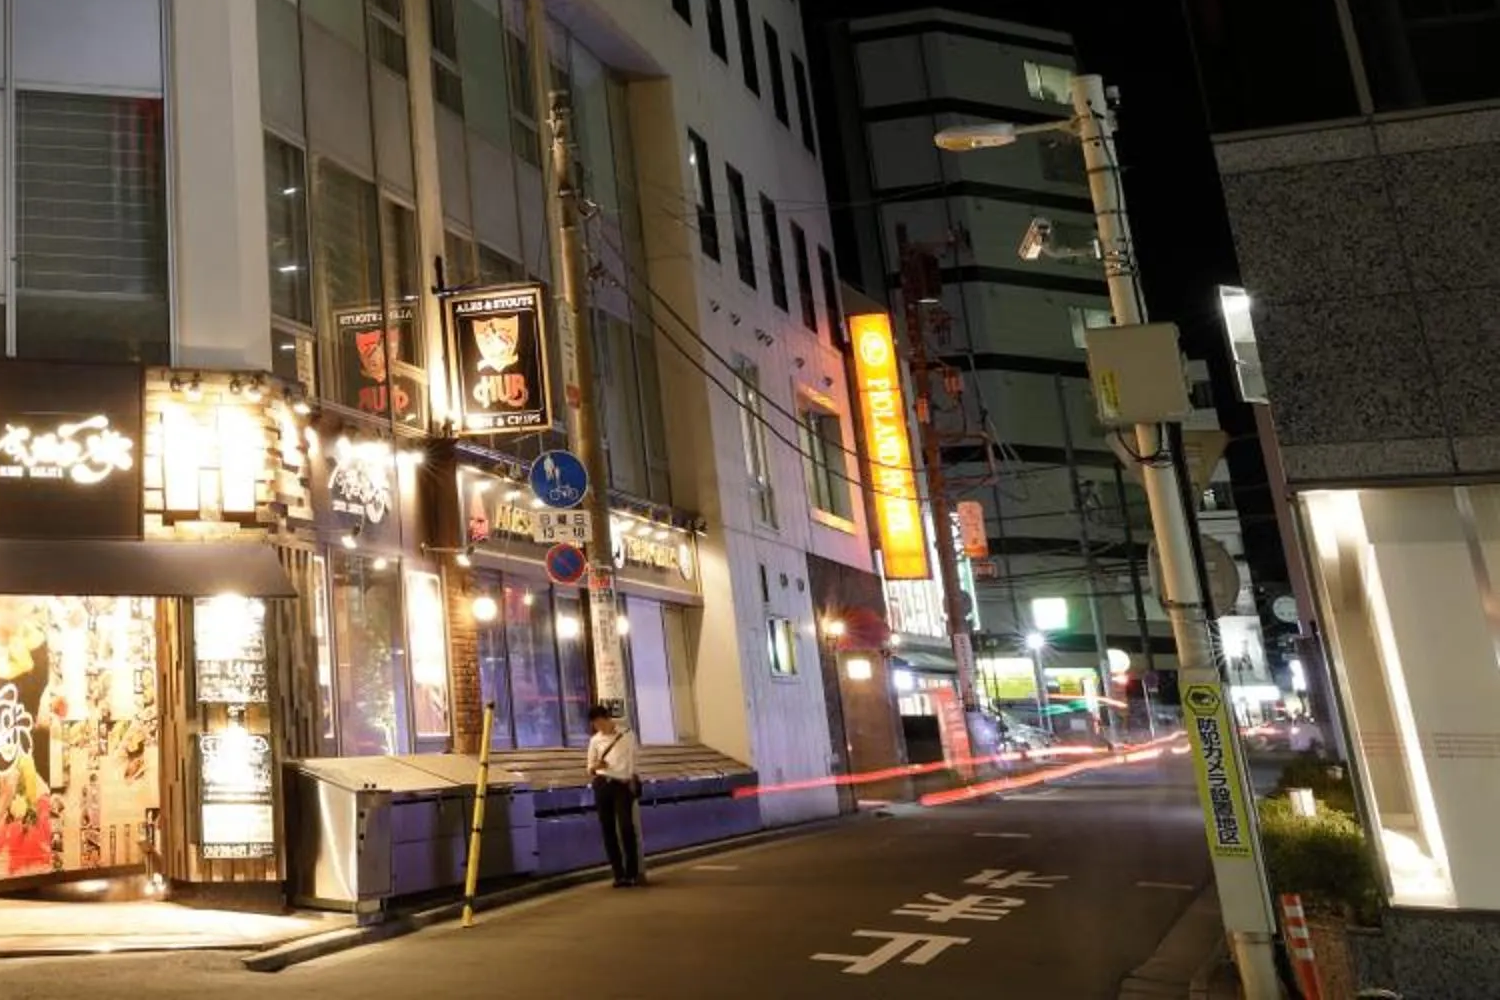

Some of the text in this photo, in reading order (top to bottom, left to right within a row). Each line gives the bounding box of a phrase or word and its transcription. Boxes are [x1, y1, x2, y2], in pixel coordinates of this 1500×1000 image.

[473, 374, 528, 408] HUB
[1197, 717, 1240, 845] 防犯カメラ設置地区
[809, 869, 1070, 975] 止まれ
